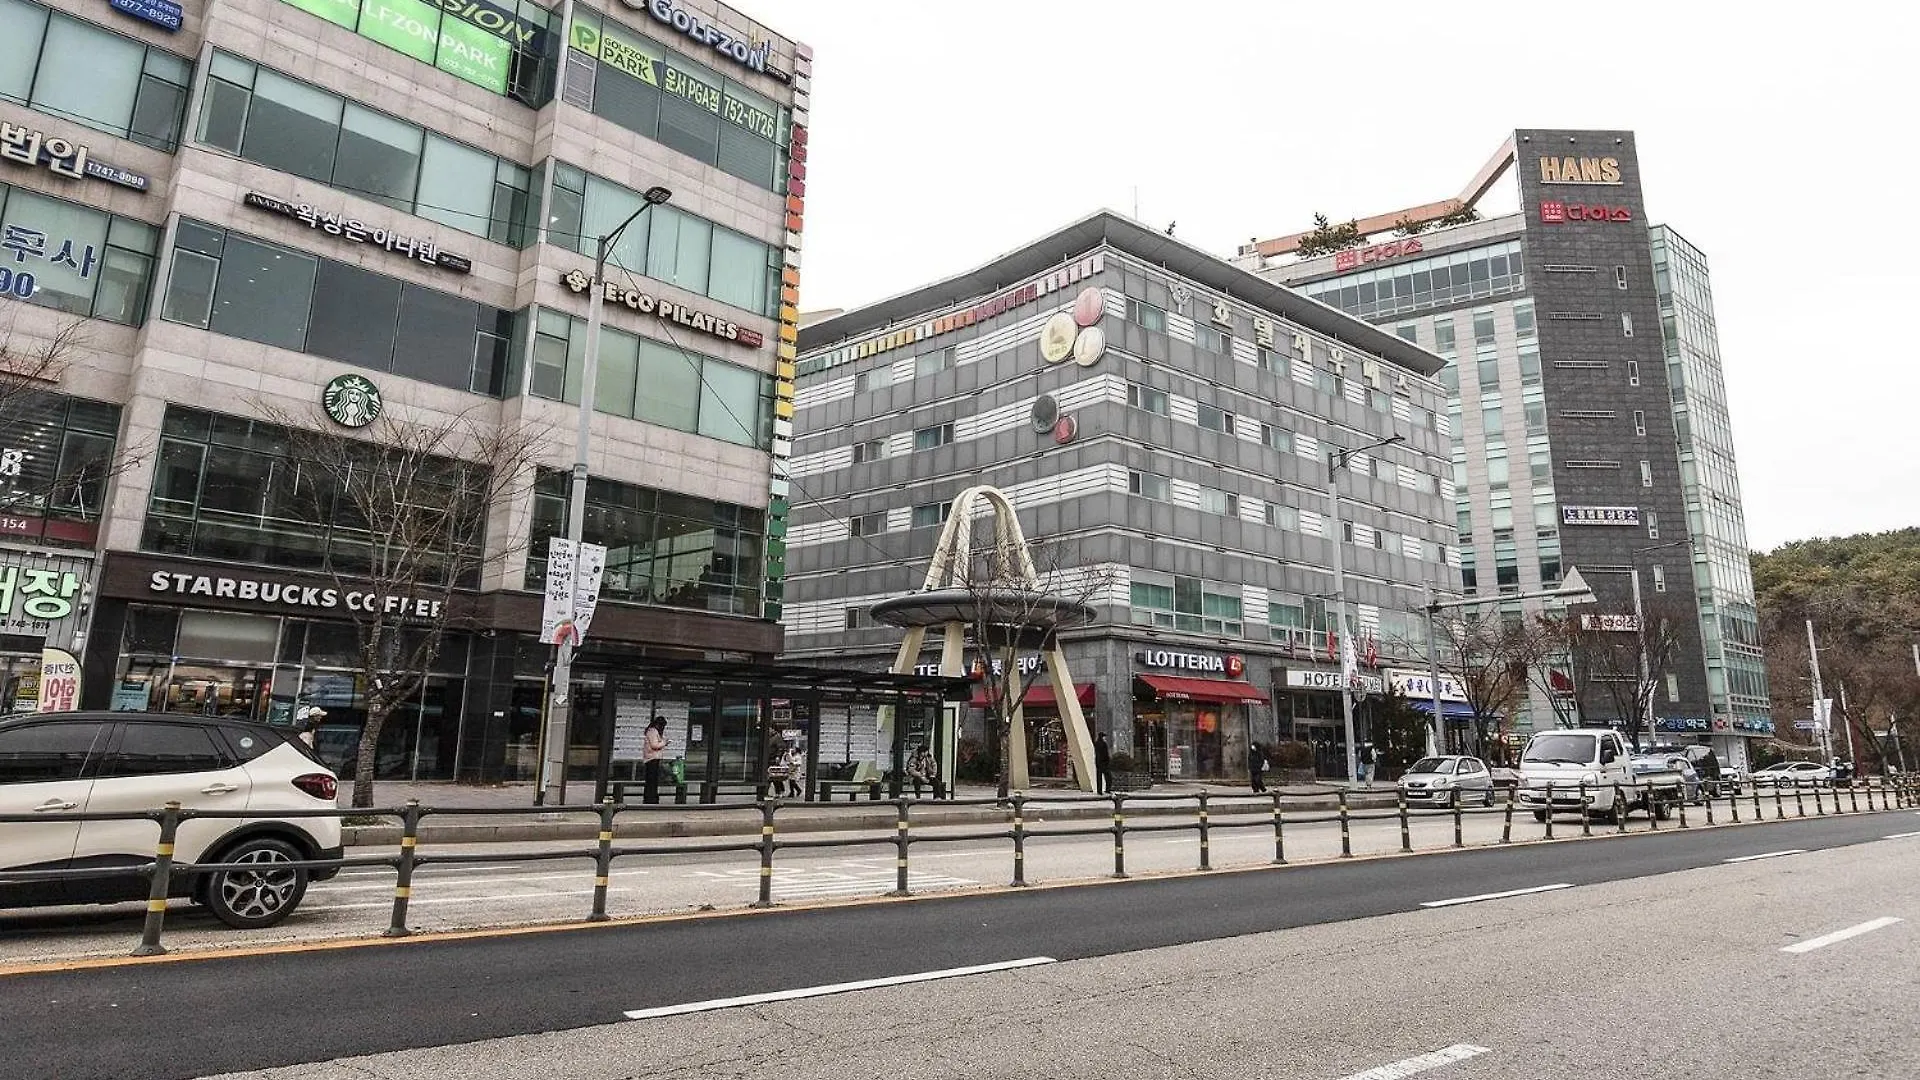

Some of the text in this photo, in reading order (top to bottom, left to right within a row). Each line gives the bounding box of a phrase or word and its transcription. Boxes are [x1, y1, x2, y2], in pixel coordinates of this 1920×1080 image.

[604, 37, 649, 64] GOLFZON
[603, 51, 648, 79] PARK
[665, 65, 686, 101] 운서
[724, 95, 774, 138] 752-0726
[1, 121, 88, 179] 법인
[1540, 156, 1620, 182] HANS
[296, 203, 367, 243] 왁싱은
[1566, 203, 1632, 222] 다이소
[1362, 239, 1423, 264] 다이소
[658, 300, 738, 341] PILATES
[150, 570, 338, 608] STARBUCKS
[1146, 649, 1224, 671] LOTTERIA
[1304, 672, 1344, 687] HOTE
